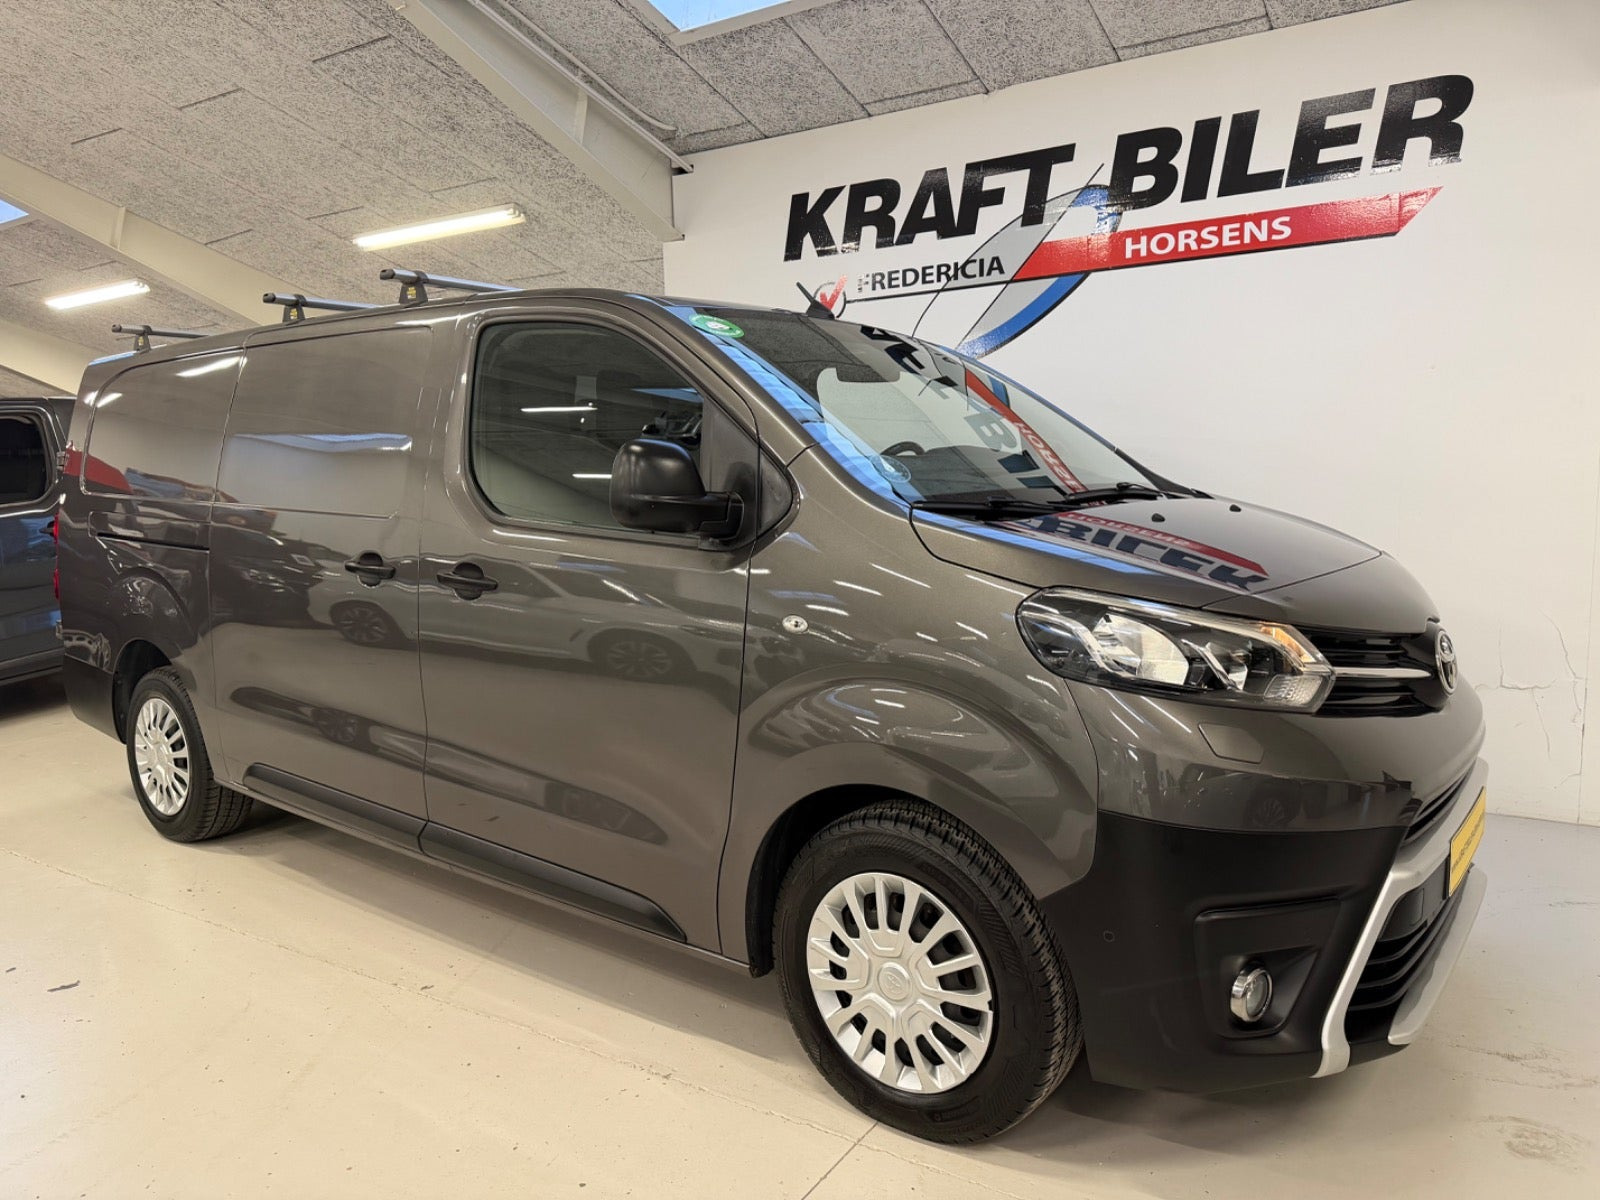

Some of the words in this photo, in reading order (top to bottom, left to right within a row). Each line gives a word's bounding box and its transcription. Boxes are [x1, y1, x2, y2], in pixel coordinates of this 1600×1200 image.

[783, 143, 1076, 262] KRAFT
[1106, 74, 1474, 212] BILER
[1124, 215, 1292, 259] HORSENS
